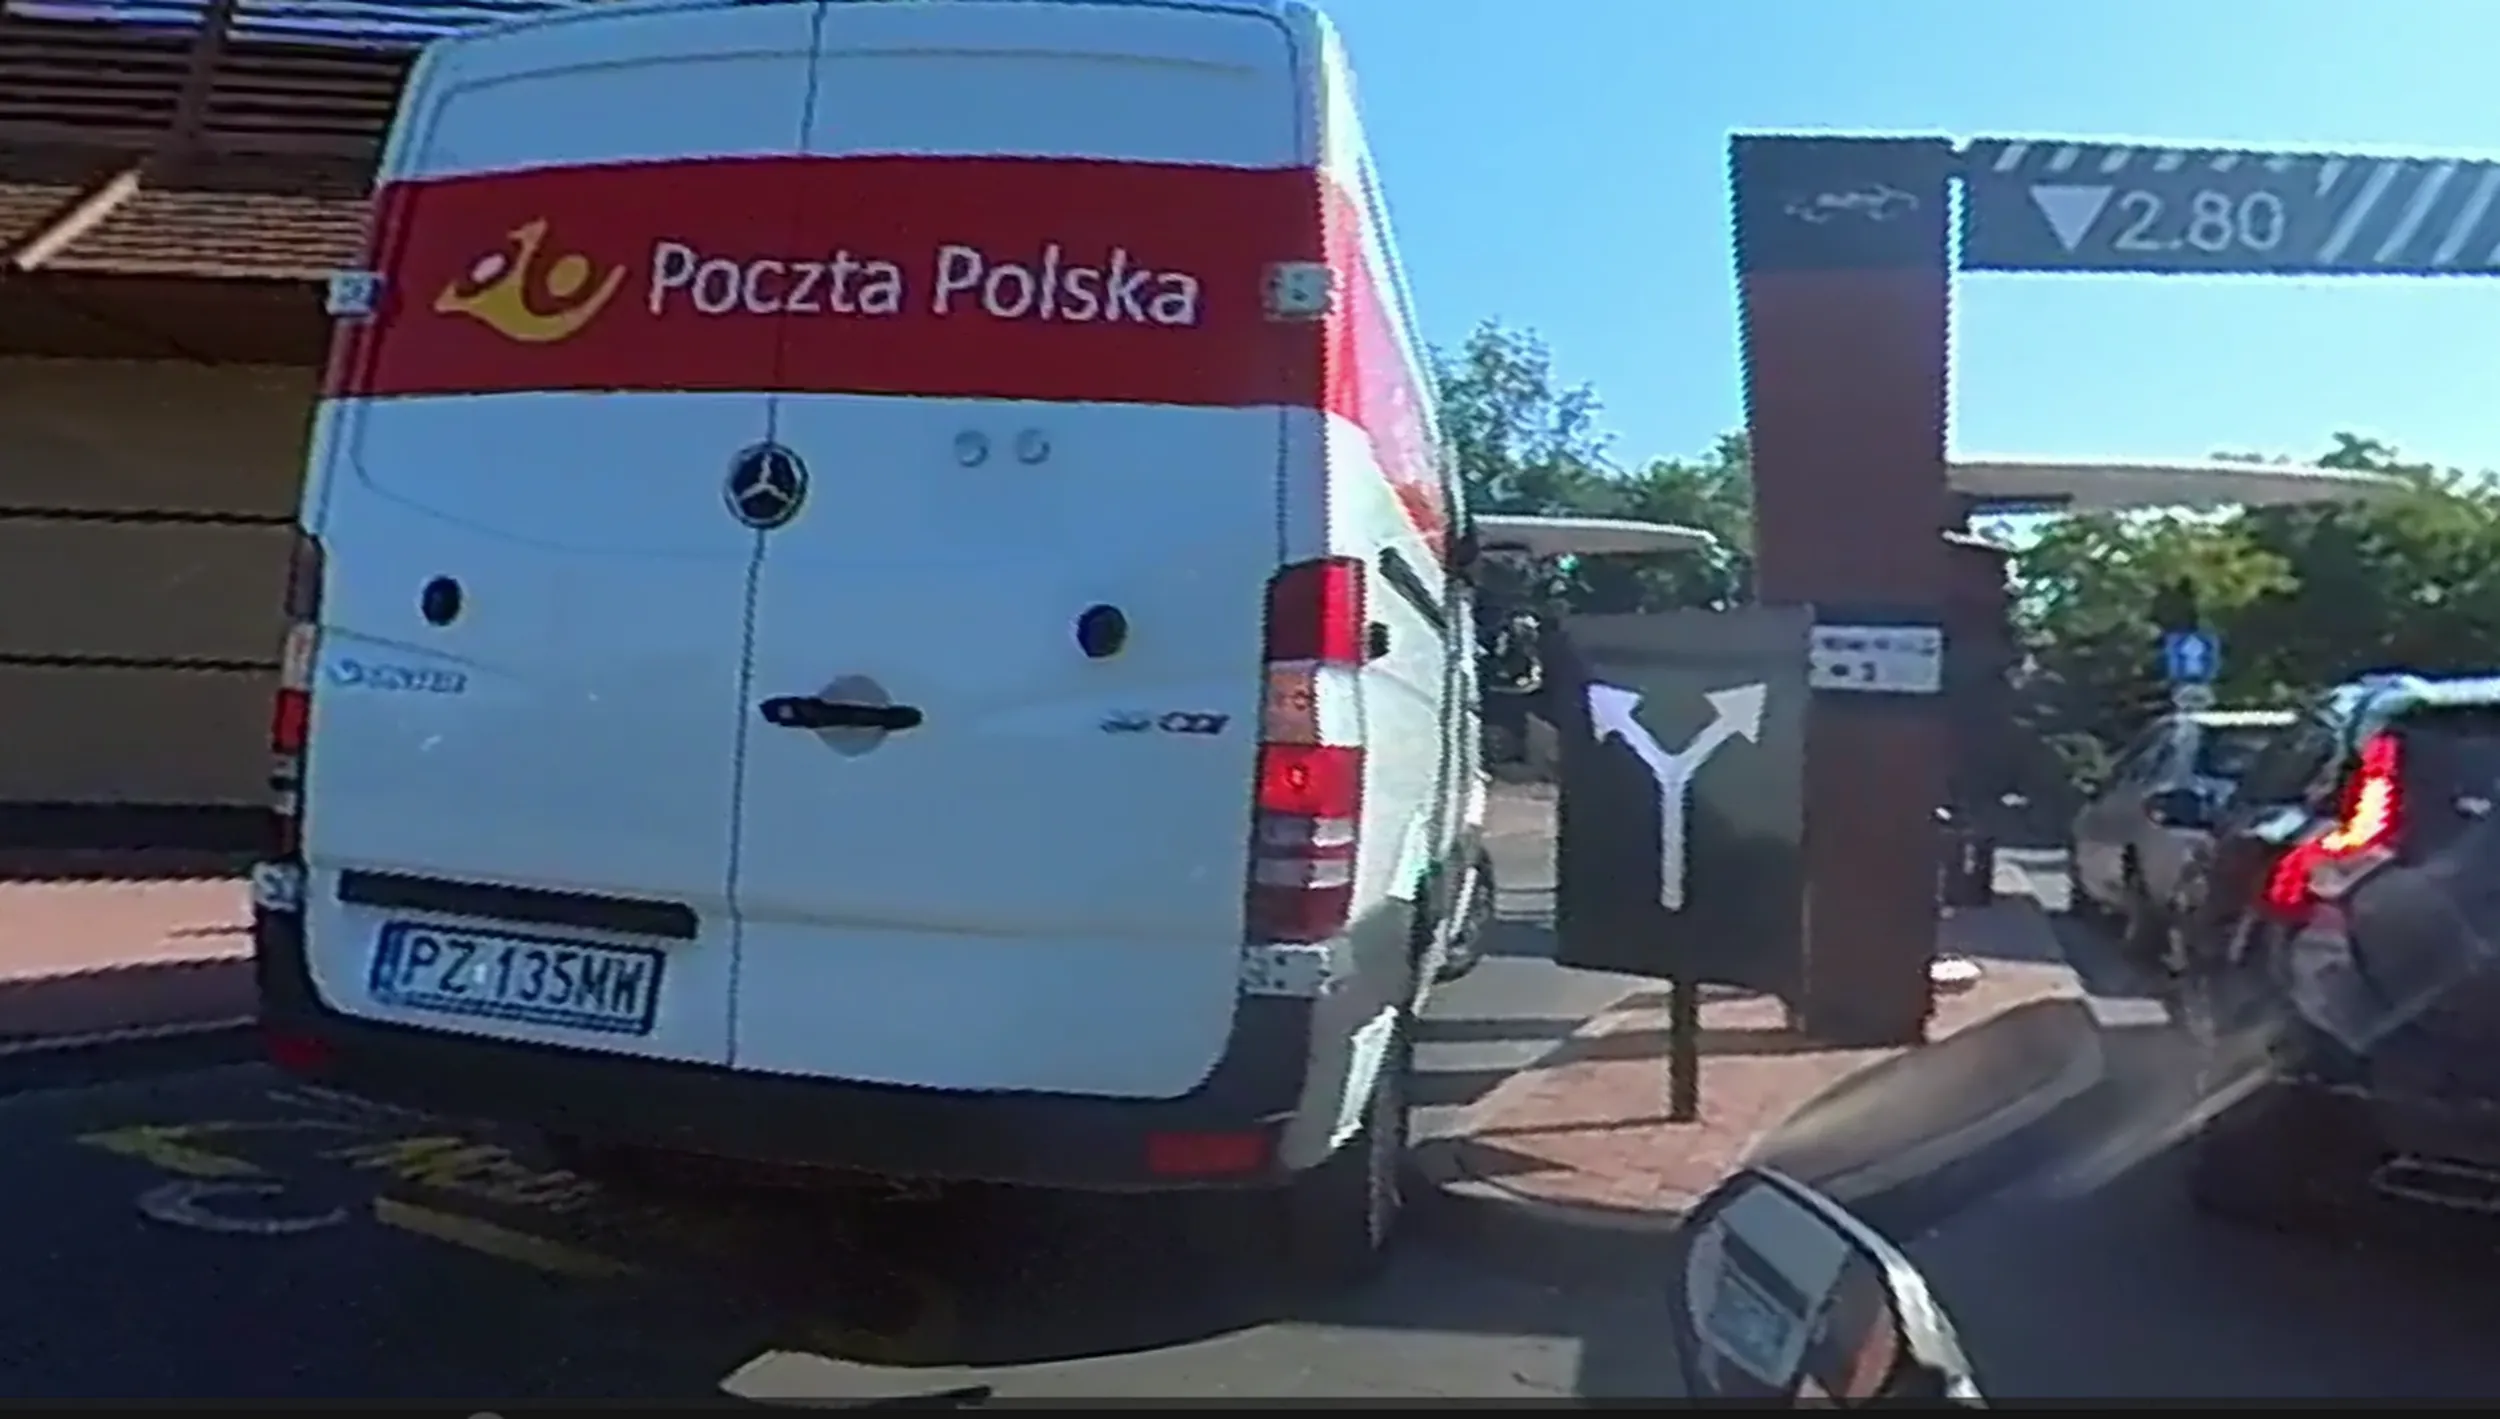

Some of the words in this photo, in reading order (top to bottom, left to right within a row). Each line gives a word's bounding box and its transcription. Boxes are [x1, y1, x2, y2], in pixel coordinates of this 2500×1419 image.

[2116, 189, 2285, 252] 2.80
[649, 240, 901, 315] Poczta
[932, 242, 1199, 326] Polska
[402, 935, 476, 994] PZ
